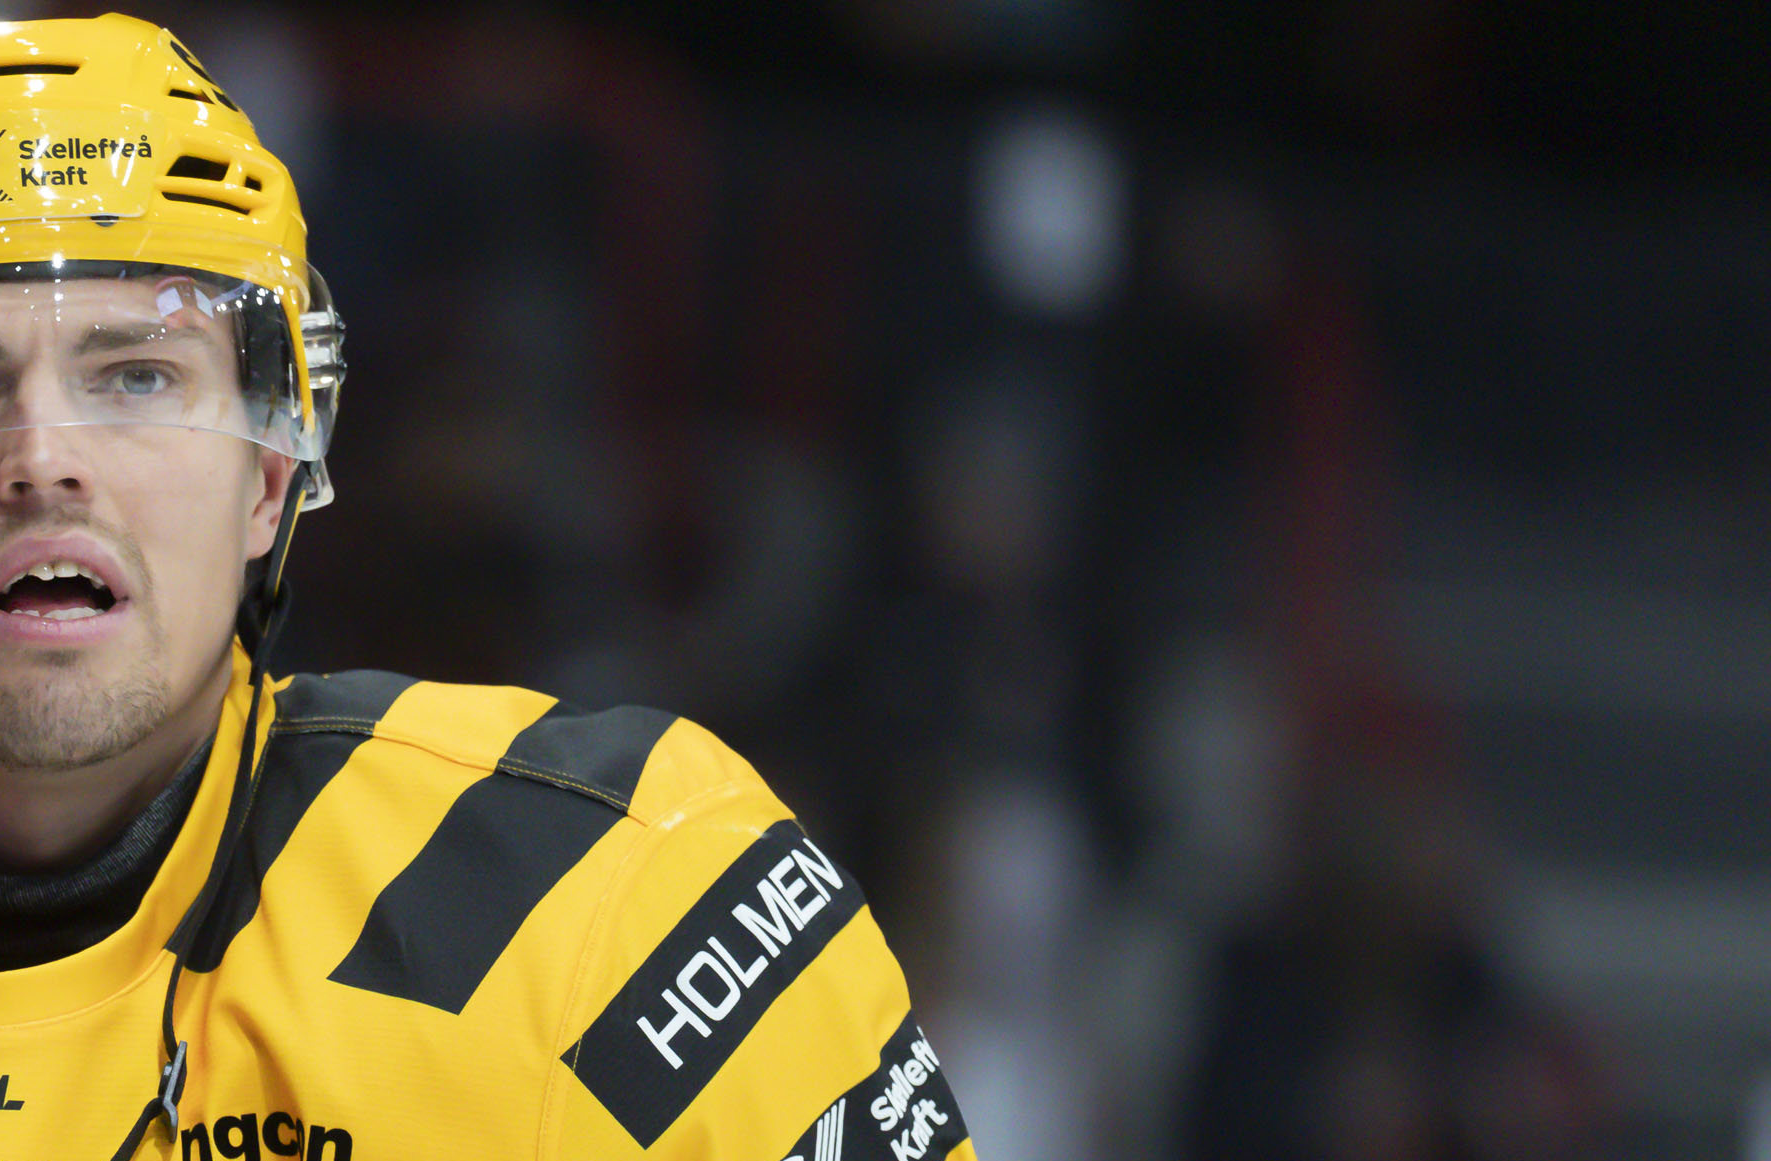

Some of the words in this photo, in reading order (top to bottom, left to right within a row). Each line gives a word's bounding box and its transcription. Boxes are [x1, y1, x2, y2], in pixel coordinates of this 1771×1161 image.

[19, 134, 152, 160] Skellefteå
[20, 166, 88, 188] Kraft
[636, 837, 844, 1070] HOLMEN
